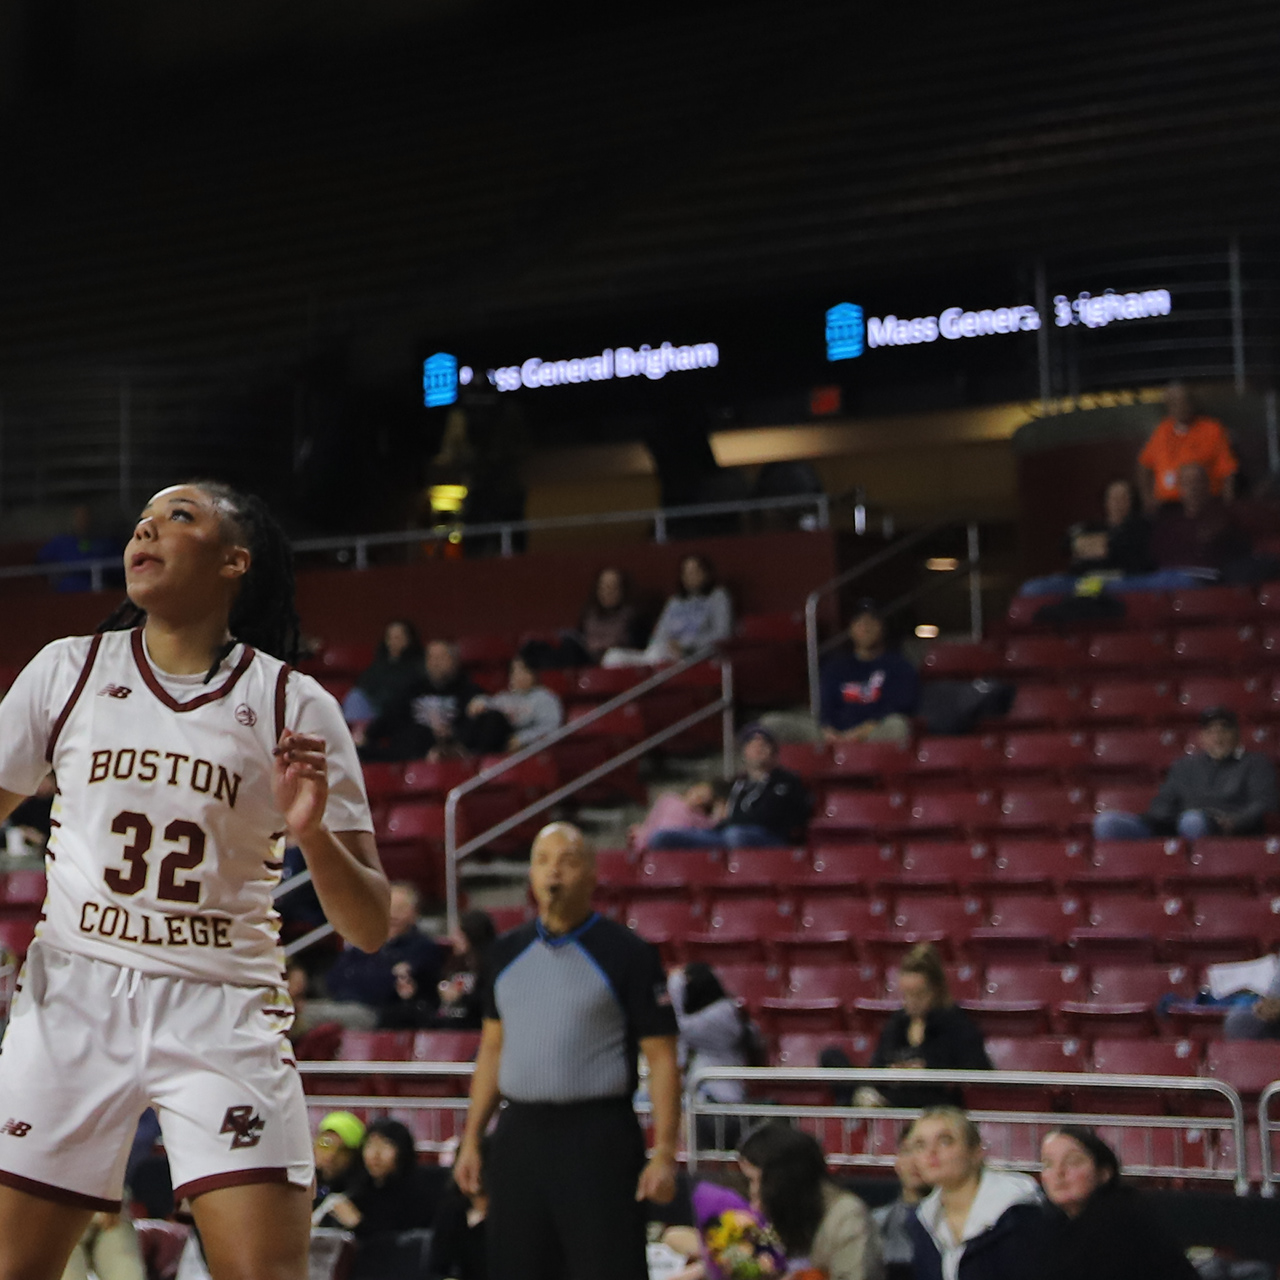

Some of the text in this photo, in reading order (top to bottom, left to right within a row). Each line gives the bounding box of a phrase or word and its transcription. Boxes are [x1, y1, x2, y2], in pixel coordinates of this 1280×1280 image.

[867, 314, 938, 348] Mass
[938, 304, 1042, 340] Genera
[521, 357, 614, 389] General
[614, 341, 719, 380] Brigham
[88, 748, 242, 808] BOSTON
[104, 810, 206, 903] 32
[79, 901, 233, 948] COLLEGE
